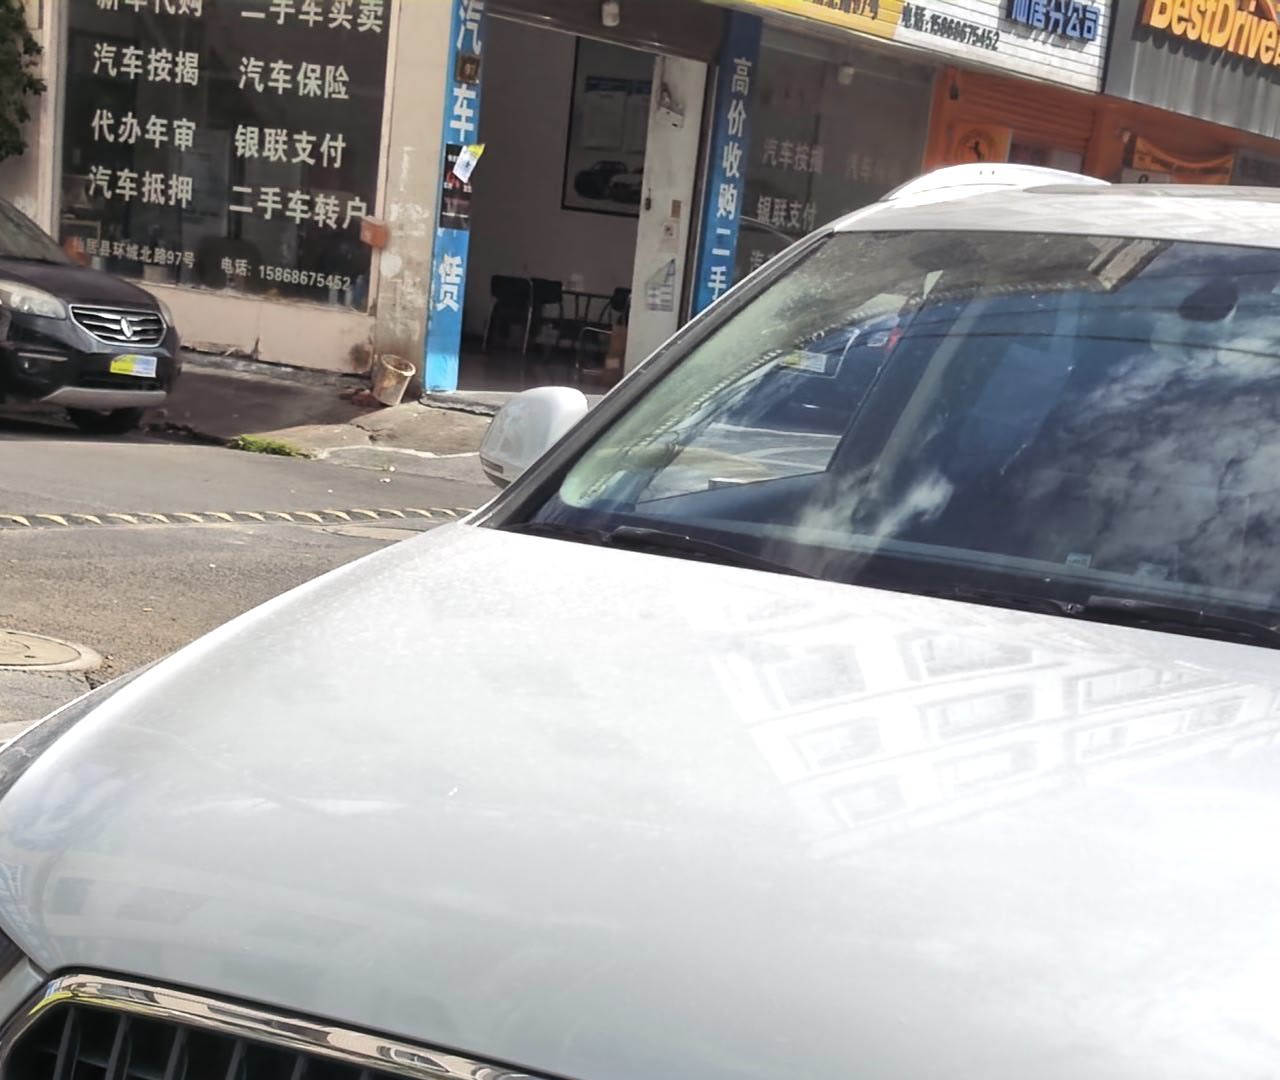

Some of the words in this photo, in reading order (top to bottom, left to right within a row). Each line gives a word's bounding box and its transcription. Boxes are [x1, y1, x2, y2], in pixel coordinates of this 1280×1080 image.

[1149, 0, 1278, 64] BestDrive
[92, 42, 200, 87] 汽车按揭
[237, 55, 350, 100] 汽车保险
[90, 108, 197, 152] 代办年审
[234, 123, 347, 169] 银联支付
[436, 0, 484, 312] 汽车赁
[87, 164, 194, 209] 汽车抵押
[228, 184, 368, 231] 二手车转户
[258, 264, 352, 291] 15868675452
